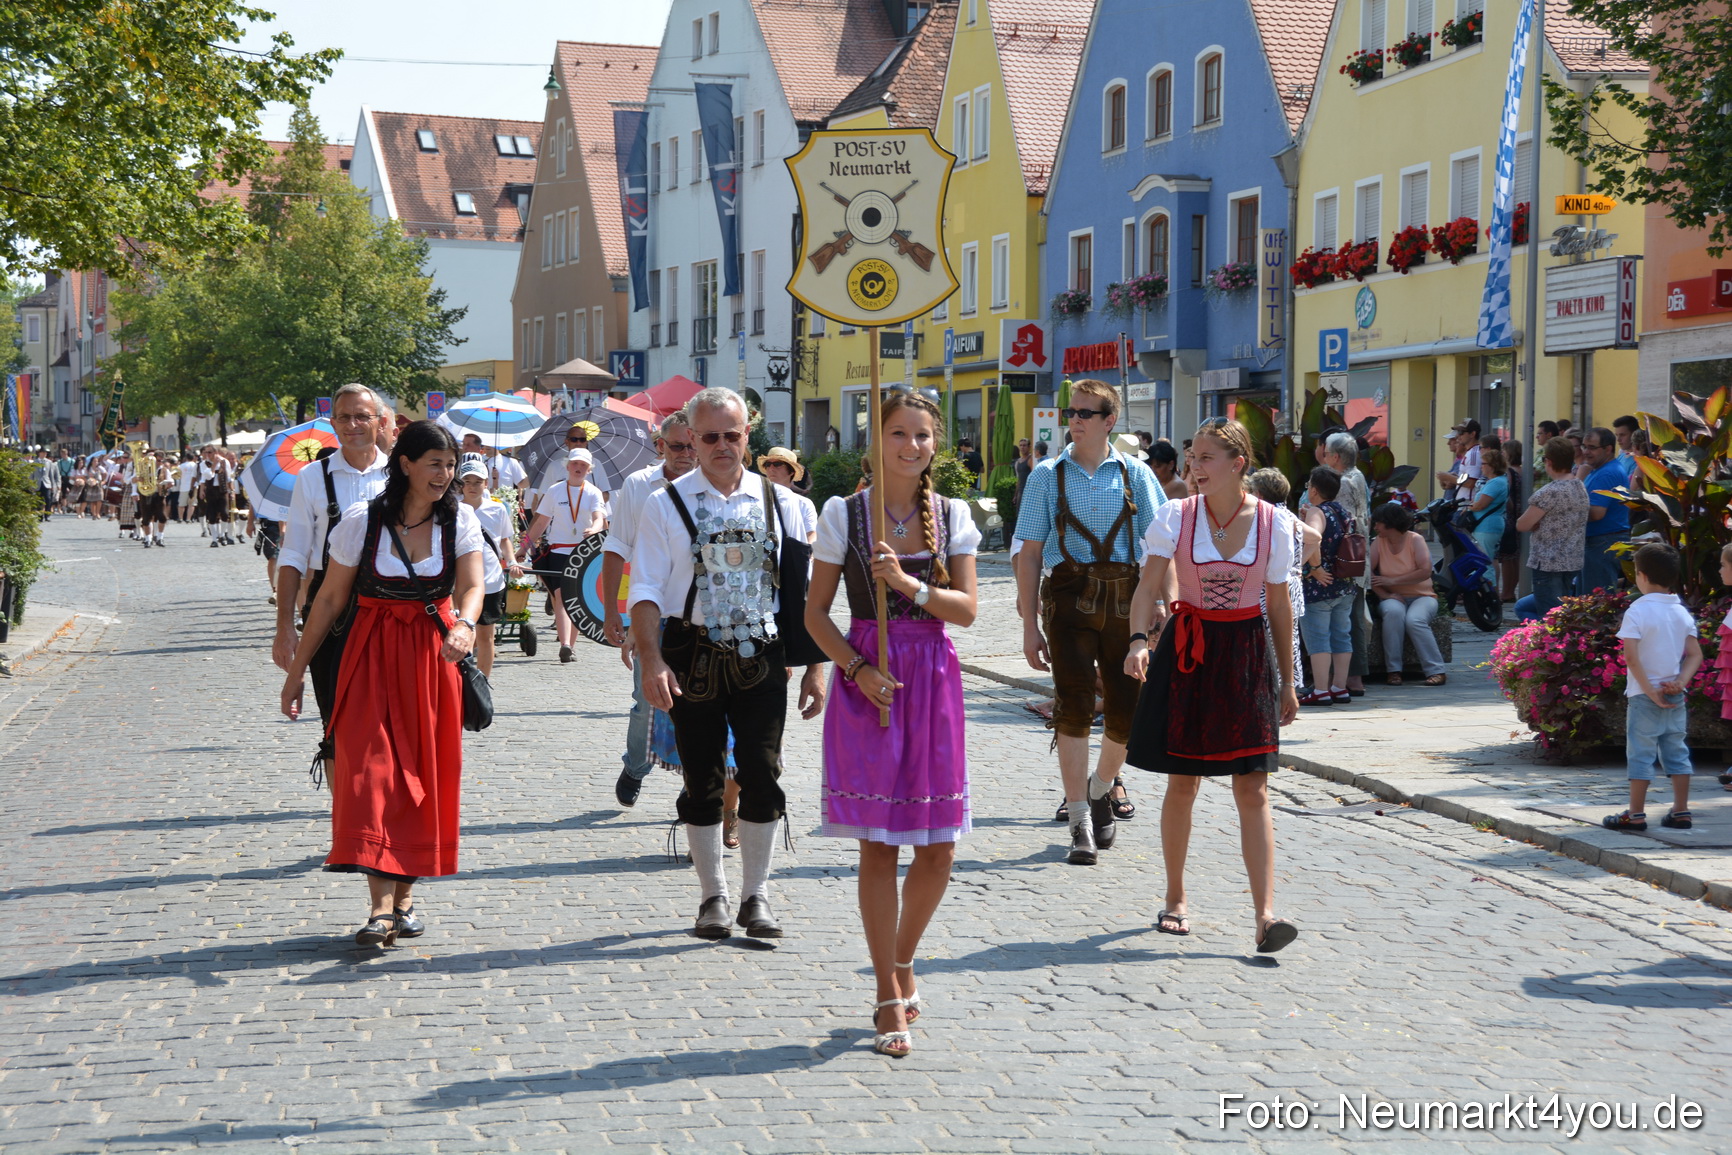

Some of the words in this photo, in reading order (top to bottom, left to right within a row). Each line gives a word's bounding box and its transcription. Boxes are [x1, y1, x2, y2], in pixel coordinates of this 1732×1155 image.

[829, 160, 911, 176] Neumarkt
[1564, 198, 1590, 211] KINO
[857, 261, 890, 274] POST-SV
[1265, 251, 1282, 338] WITTL
[1621, 261, 1634, 341] KINO
[1556, 299, 1583, 318] RIALTO
[1585, 296, 1605, 313] KINO
[882, 348, 917, 356] TAIFN
[953, 336, 977, 353] AIFUN
[1325, 334, 1342, 368] P
